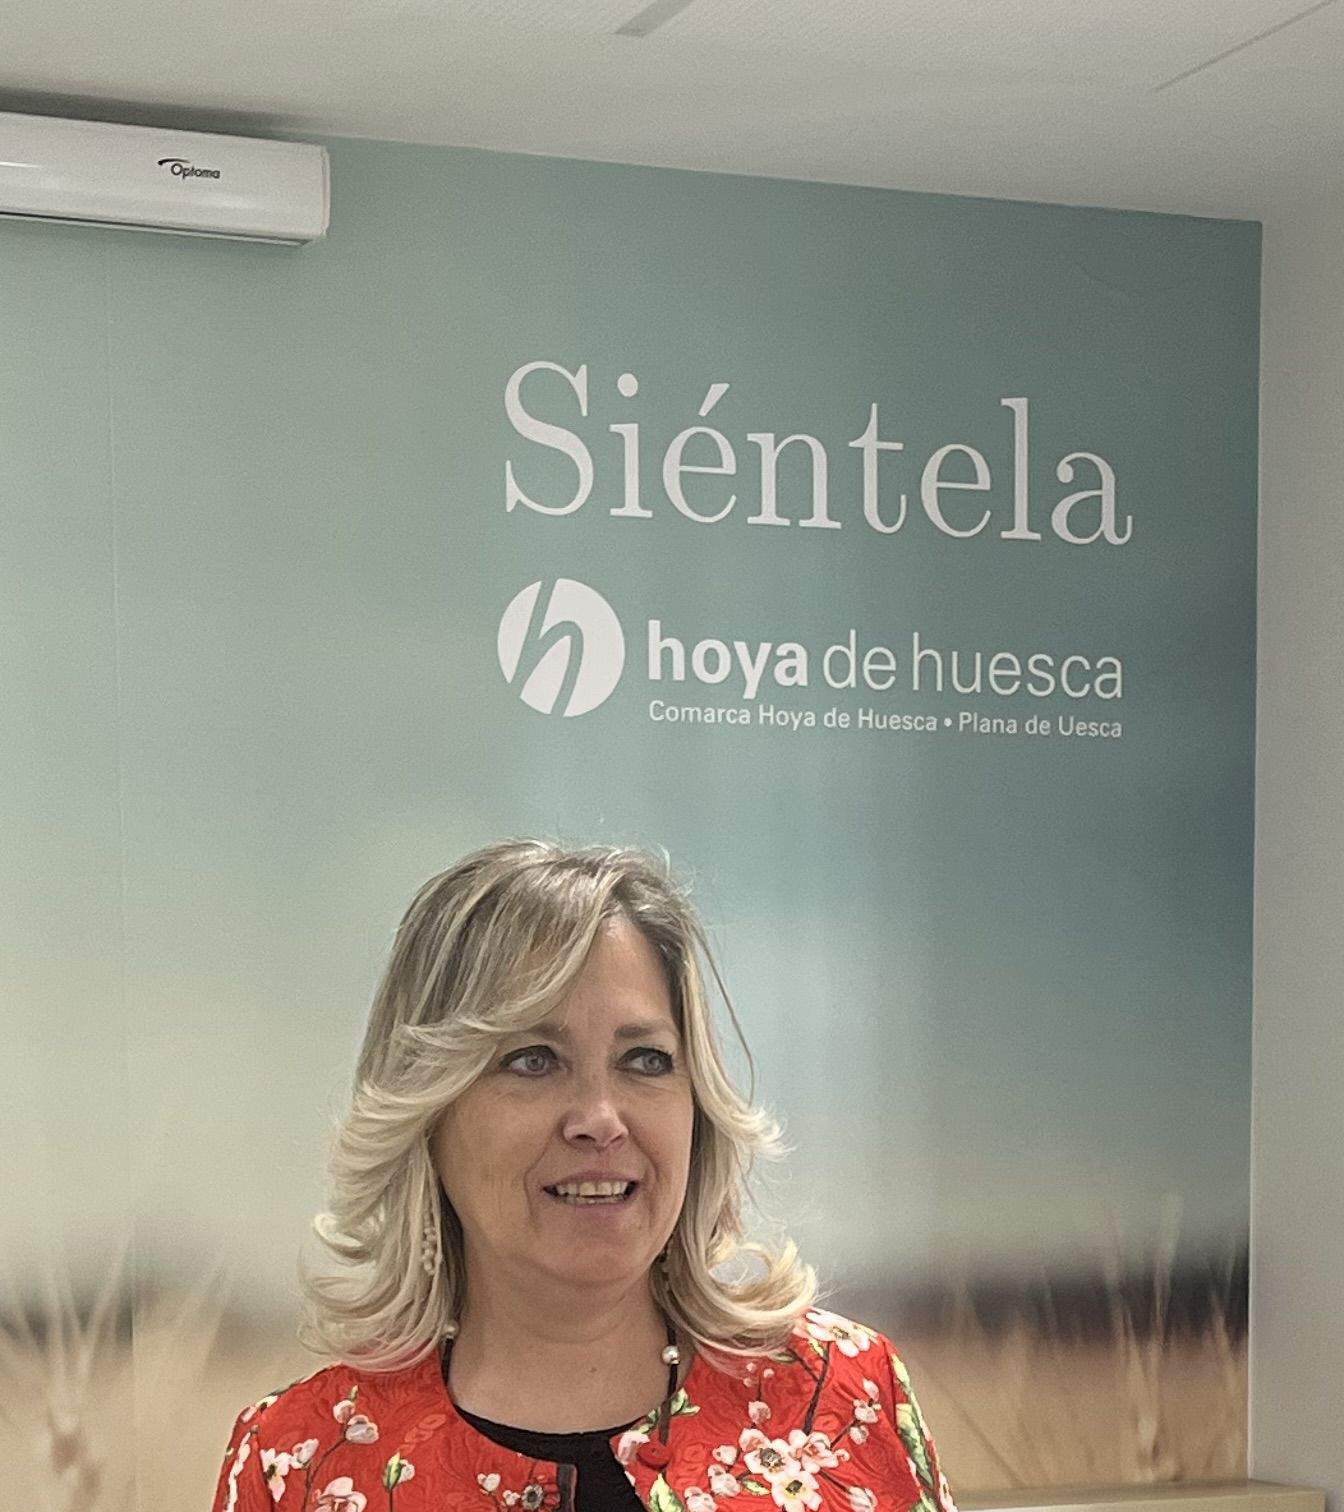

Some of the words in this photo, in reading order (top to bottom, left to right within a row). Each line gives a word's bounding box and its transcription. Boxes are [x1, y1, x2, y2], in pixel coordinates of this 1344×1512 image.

[170, 163, 221, 180] Optoma
[504, 360, 1133, 546] Siéntela
[648, 619, 808, 700] hoya
[823, 629, 897, 691] de
[912, 632, 1123, 700] huesca
[648, 699, 752, 726] Comarca
[759, 704, 818, 734] Hoya
[823, 707, 851, 730] de
[858, 708, 938, 732] Huesca
[959, 712, 1018, 736] Plana
[1024, 714, 1052, 736] de
[1058, 715, 1123, 739] Uesca
